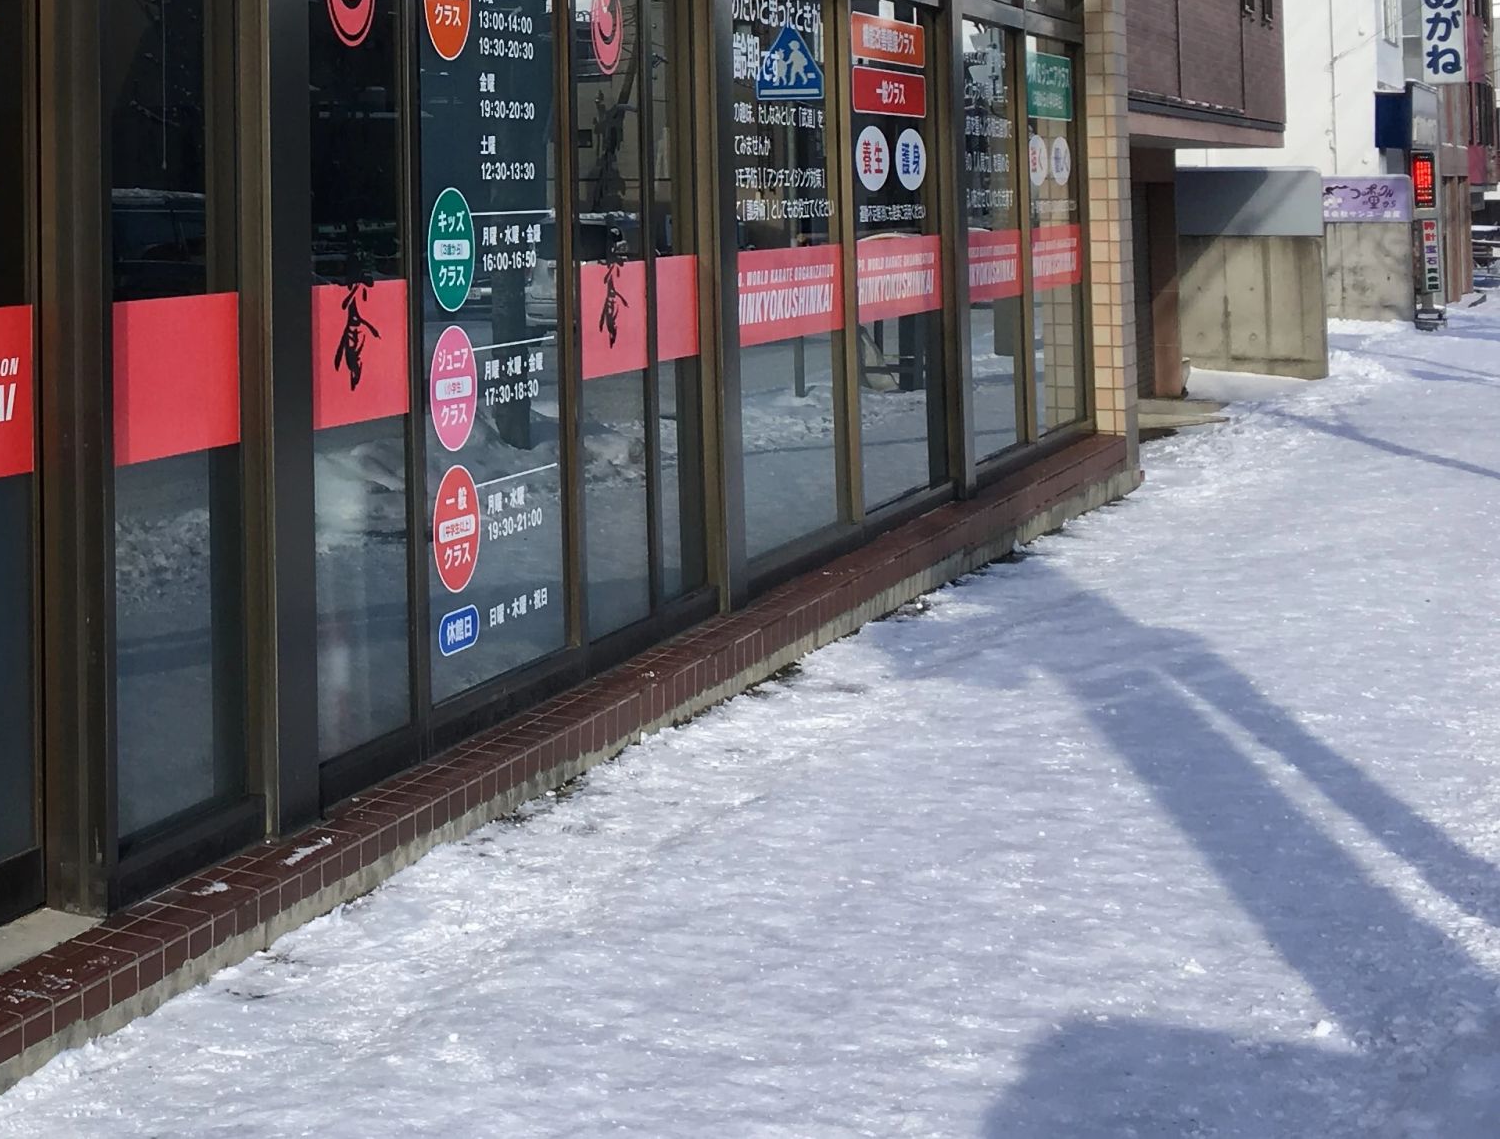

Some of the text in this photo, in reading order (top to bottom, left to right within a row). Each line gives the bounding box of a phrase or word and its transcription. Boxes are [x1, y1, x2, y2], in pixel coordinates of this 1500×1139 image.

[435, 3, 462, 26] クラス
[479, 72, 495, 92] 金曜
[876, 80, 906, 104] 一般クラス
[480, 135, 496, 155] 土曜
[438, 211, 465, 233] キッズ
[439, 265, 465, 287] クラス
[438, 348, 468, 371] ジュニア
[441, 404, 467, 427] クラス
[446, 487, 468, 510] 一般
[444, 542, 471, 569] クラス
[447, 615, 472, 646] 休館日
